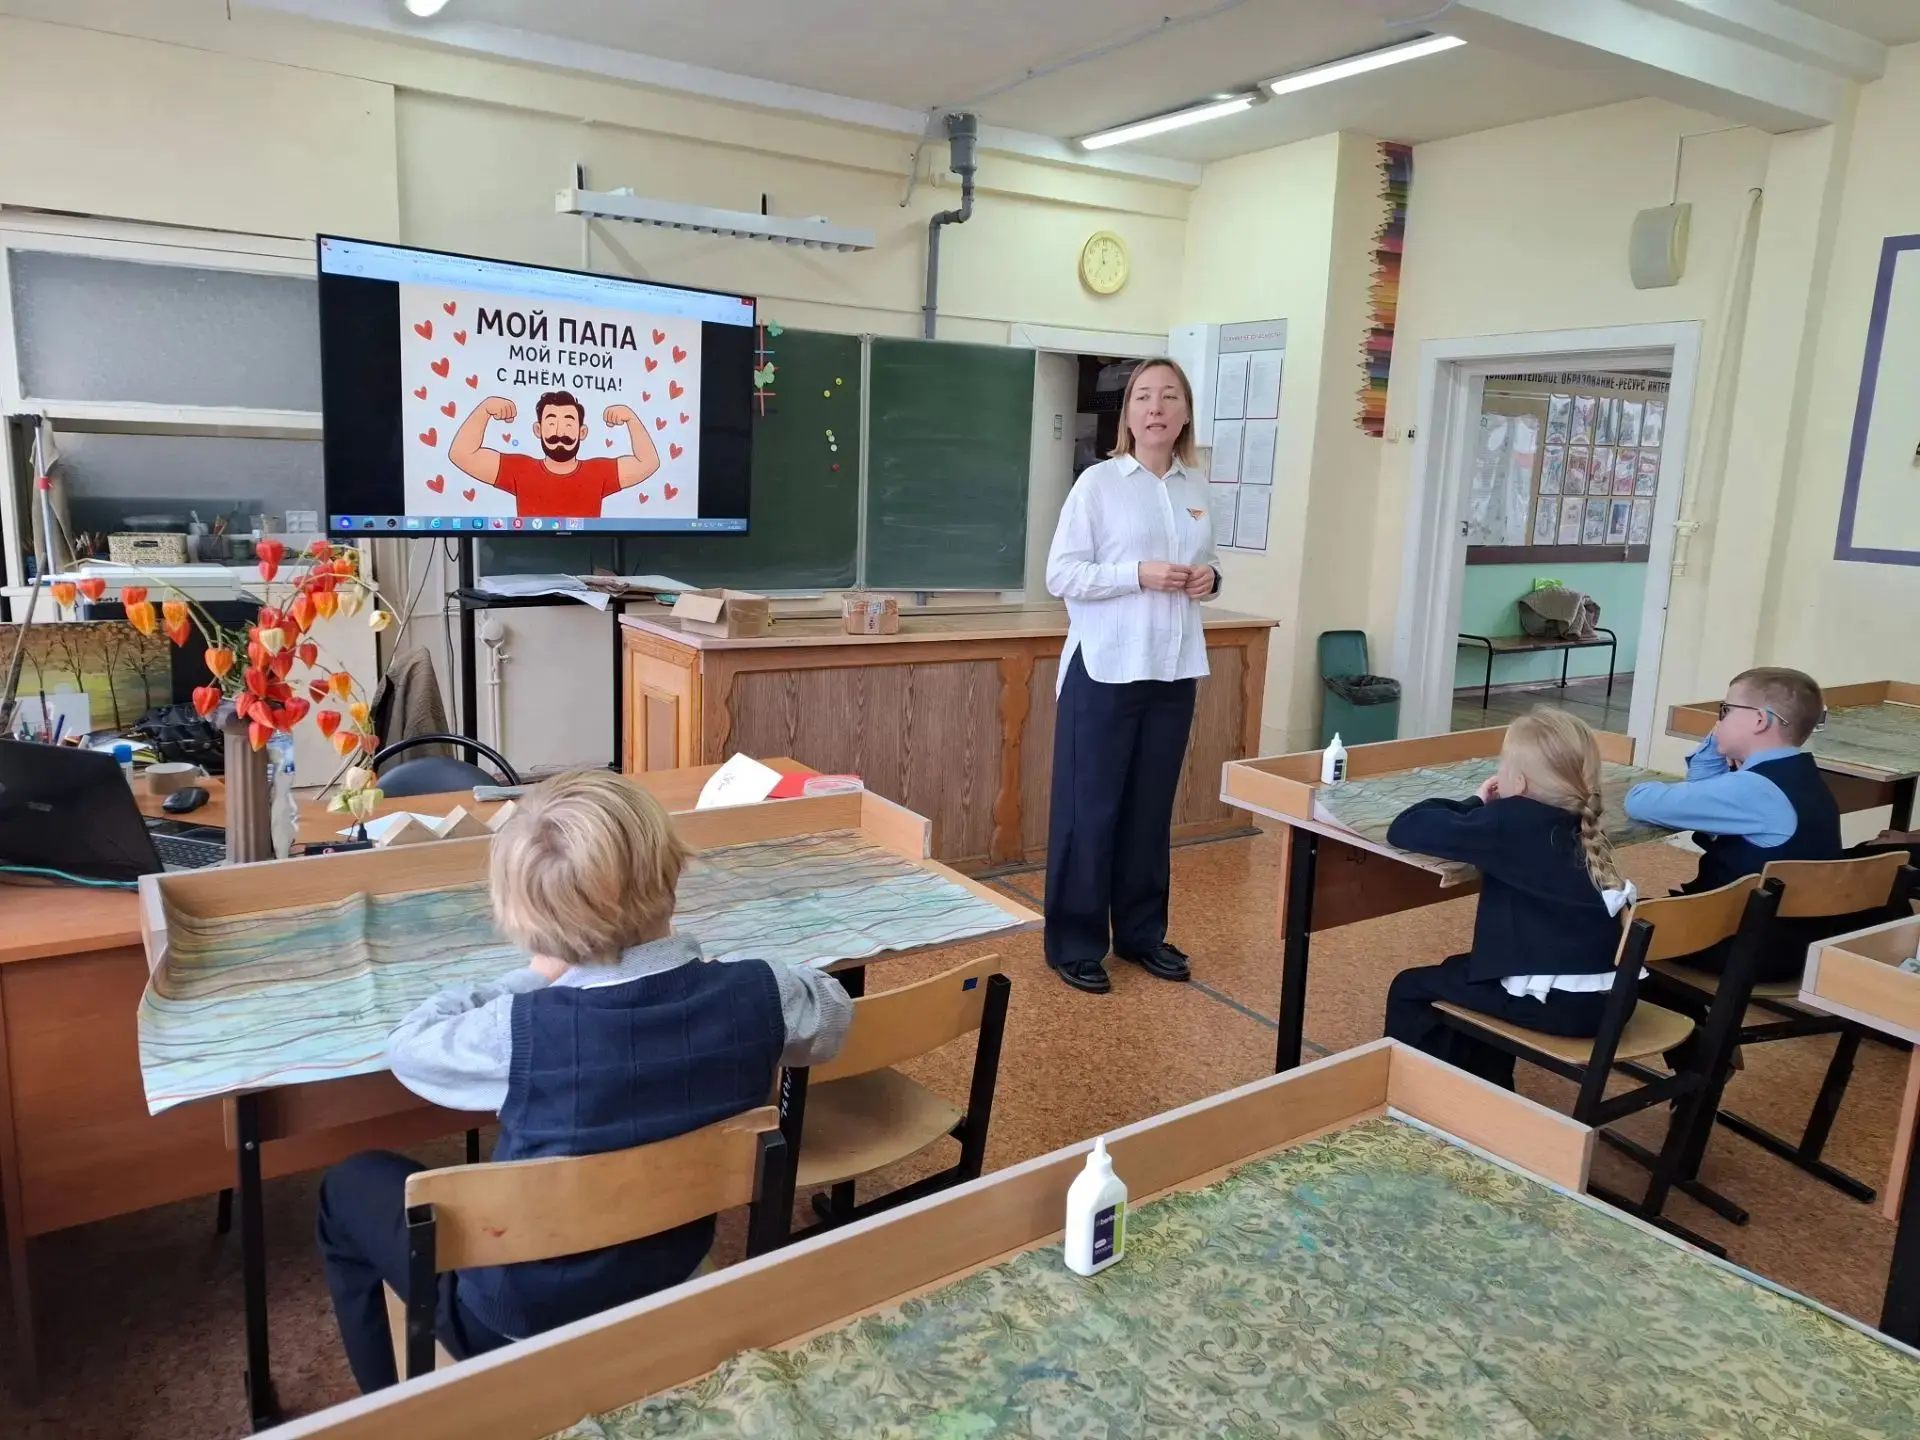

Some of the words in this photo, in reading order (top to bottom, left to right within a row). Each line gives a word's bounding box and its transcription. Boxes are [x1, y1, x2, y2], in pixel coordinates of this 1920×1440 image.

[477, 308, 547, 342] МОЙ
[559, 317, 637, 351] ПАПА
[509, 345, 550, 363] МОЙ
[558, 349, 613, 370] ГЕРОЙ
[497, 367, 507, 382] С
[514, 368, 566, 389] ДНЁМ
[572, 374, 622, 392] ОТЦА!
